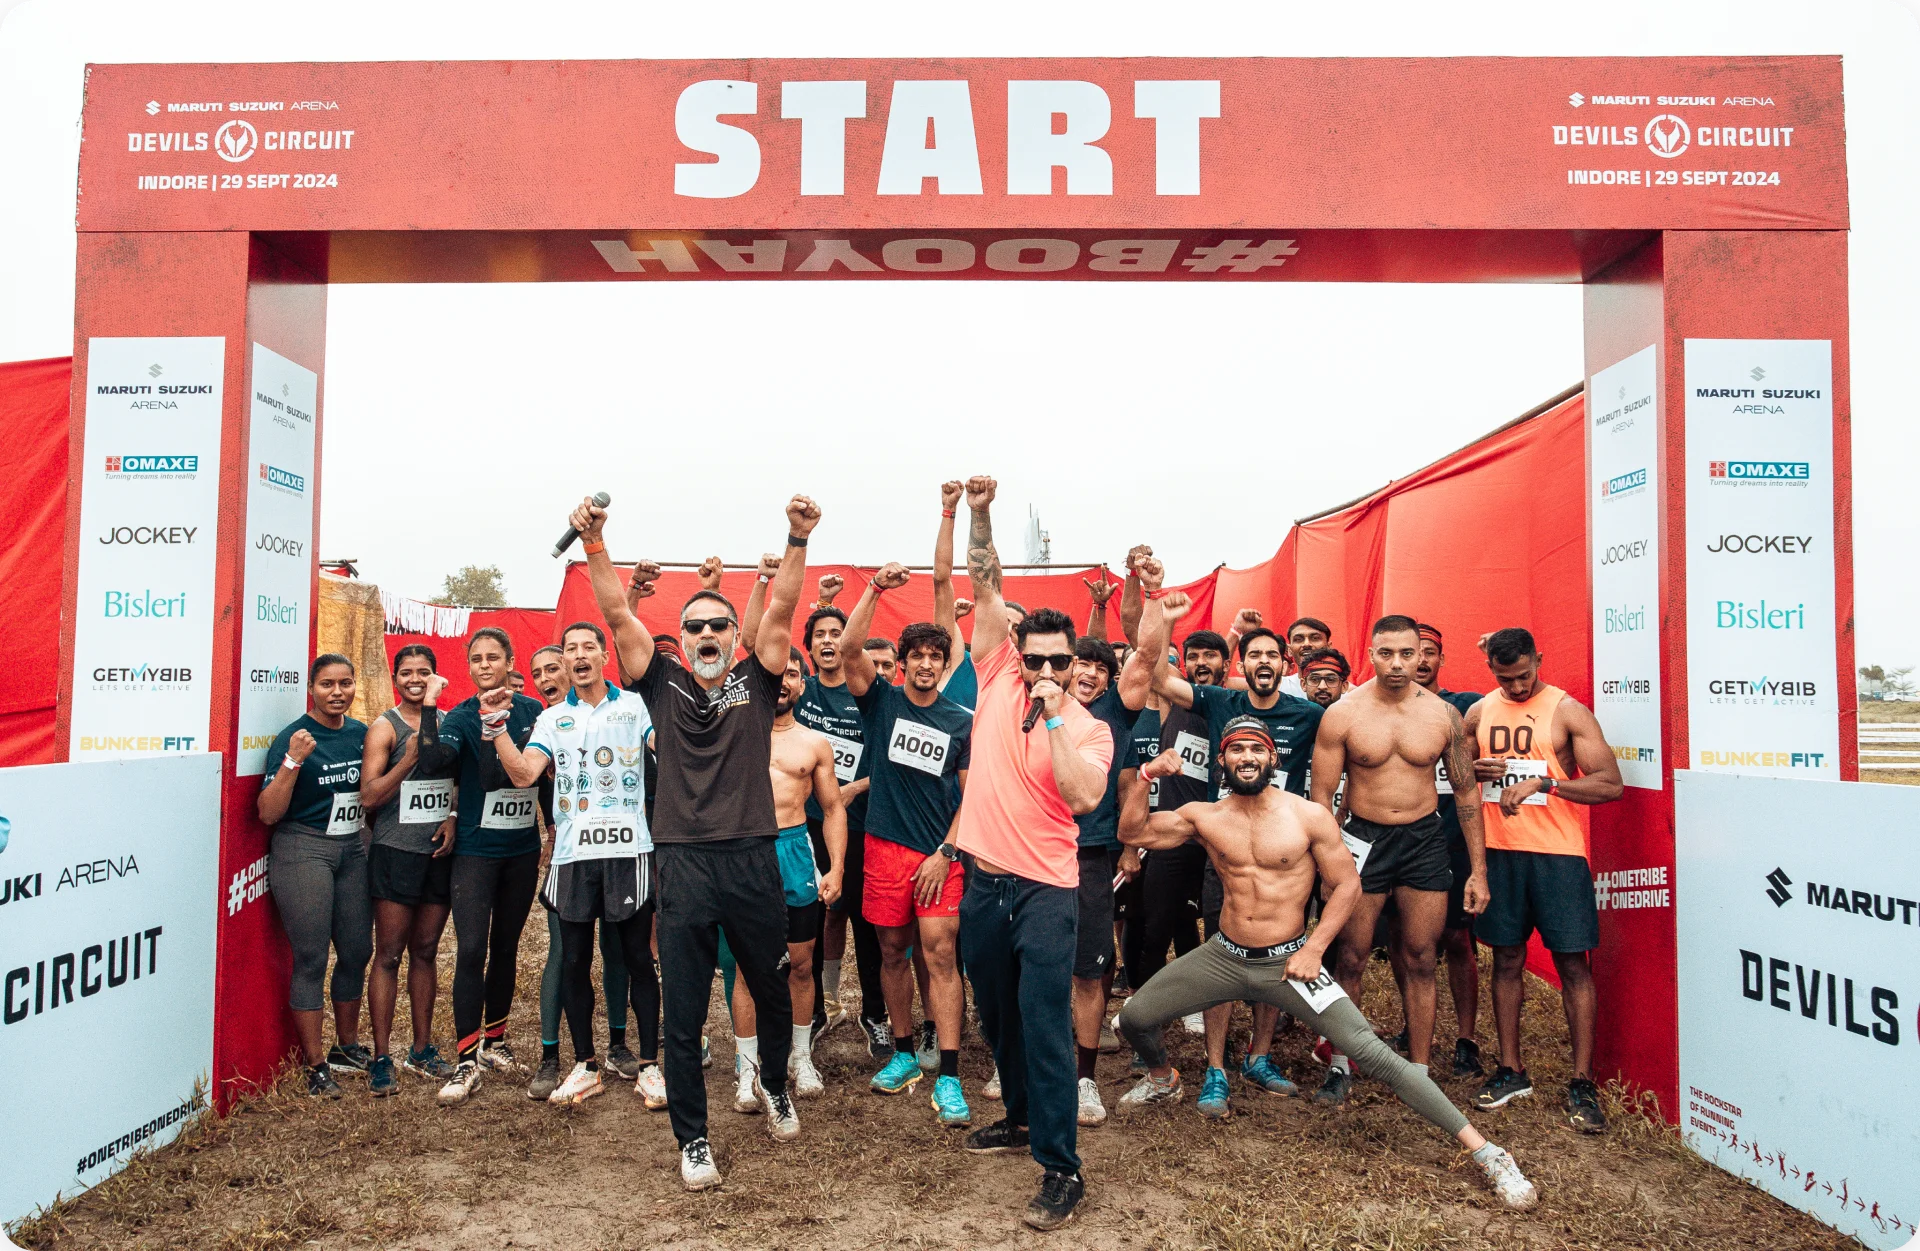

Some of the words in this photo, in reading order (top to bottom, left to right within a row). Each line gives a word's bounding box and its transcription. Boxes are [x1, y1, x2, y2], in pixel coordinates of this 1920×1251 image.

[167, 102, 223, 113] MARUTI
[228, 102, 284, 112] SUZUKI
[290, 101, 340, 111] ARENA
[1591, 95, 1650, 106] MARUTI
[1656, 96, 1716, 106] SUZUKI
[1722, 96, 1775, 107] ARENA
[127, 132, 209, 152] DEVILS
[264, 130, 355, 151] CIRCUIT
[674, 79, 1221, 199] START
[1552, 125, 1638, 146] DEVILS
[1697, 127, 1794, 147] CIRCUIT
[137, 175, 208, 190] INDORE
[220, 174, 243, 189] 29
[246, 174, 291, 189] SEPT
[293, 173, 339, 188] 2024
[1567, 170, 1641, 185] INDORE
[1655, 170, 1678, 185] 29
[1682, 171, 1728, 186] SEPT
[1731, 171, 1781, 186] 2024
[589, 238, 1301, 274] #BOOYAH
[97, 385, 152, 395] MARUTI
[158, 385, 213, 395] SUZUKI
[1696, 388, 1755, 399] MARUTI
[1762, 389, 1821, 399] SUZUKI
[129, 400, 178, 410] ARENA
[256, 391, 284, 411] MARUTI
[286, 405, 312, 423] SUZUKI
[1595, 408, 1621, 427] MARUTI
[1623, 395, 1651, 415] SUZUKI
[1732, 404, 1785, 415] ARENA
[272, 414, 296, 430] ARENA
[124, 457, 197, 471] OMAXE
[1730, 463, 1808, 477] OMAXE
[105, 473, 131, 481] Turning
[175, 473, 197, 481] reality
[269, 468, 303, 490] OMAXE
[1610, 470, 1646, 492] OMAXE
[1709, 479, 1738, 488] Turning
[1739, 479, 1767, 487] dreams
[1784, 480, 1809, 488] reality
[99, 526, 198, 545] JOCKEY
[255, 533, 304, 558] JOCKEY
[1707, 534, 1813, 554] JOCKEY
[1600, 538, 1648, 566] JOCKEY
[104, 589, 186, 618] Bisleri
[256, 594, 297, 625] Bisleri
[1605, 604, 1645, 634] Bisleri
[1716, 599, 1804, 630] Bisleri
[93, 662, 192, 682] GETMYBIB
[250, 665, 299, 684] GETMYBIB
[1602, 675, 1651, 694] GETMYBIB
[1709, 675, 1816, 696] GETMYBIB
[1773, 698, 1815, 706] ACTIVE
[892, 732, 945, 762] A009
[1489, 725, 1533, 755] DO
[834, 750, 856, 769] 29
[1180, 746, 1209, 768] A0
[318, 773, 346, 785] DEVILS
[409, 792, 450, 810] A015
[491, 800, 533, 817] A012
[578, 827, 633, 846] A050
[56, 854, 140, 892] ARENA
[1611, 889, 1670, 910] ONEDRIVE
[1806, 881, 1920, 928] MARUT
[1268, 942, 1298, 957] NIKE
[4, 925, 163, 1025] CIRCUIT
[1303, 971, 1335, 997] A0
[1738, 948, 1900, 1047] DEVILS
[1689, 1085, 1703, 1100] THE
[1704, 1092, 1743, 1118] ROCKSTAR
[1690, 1100, 1699, 1112] OF
[1700, 1105, 1736, 1130] RUNNING
[1690, 1115, 1717, 1137] EVENTS
